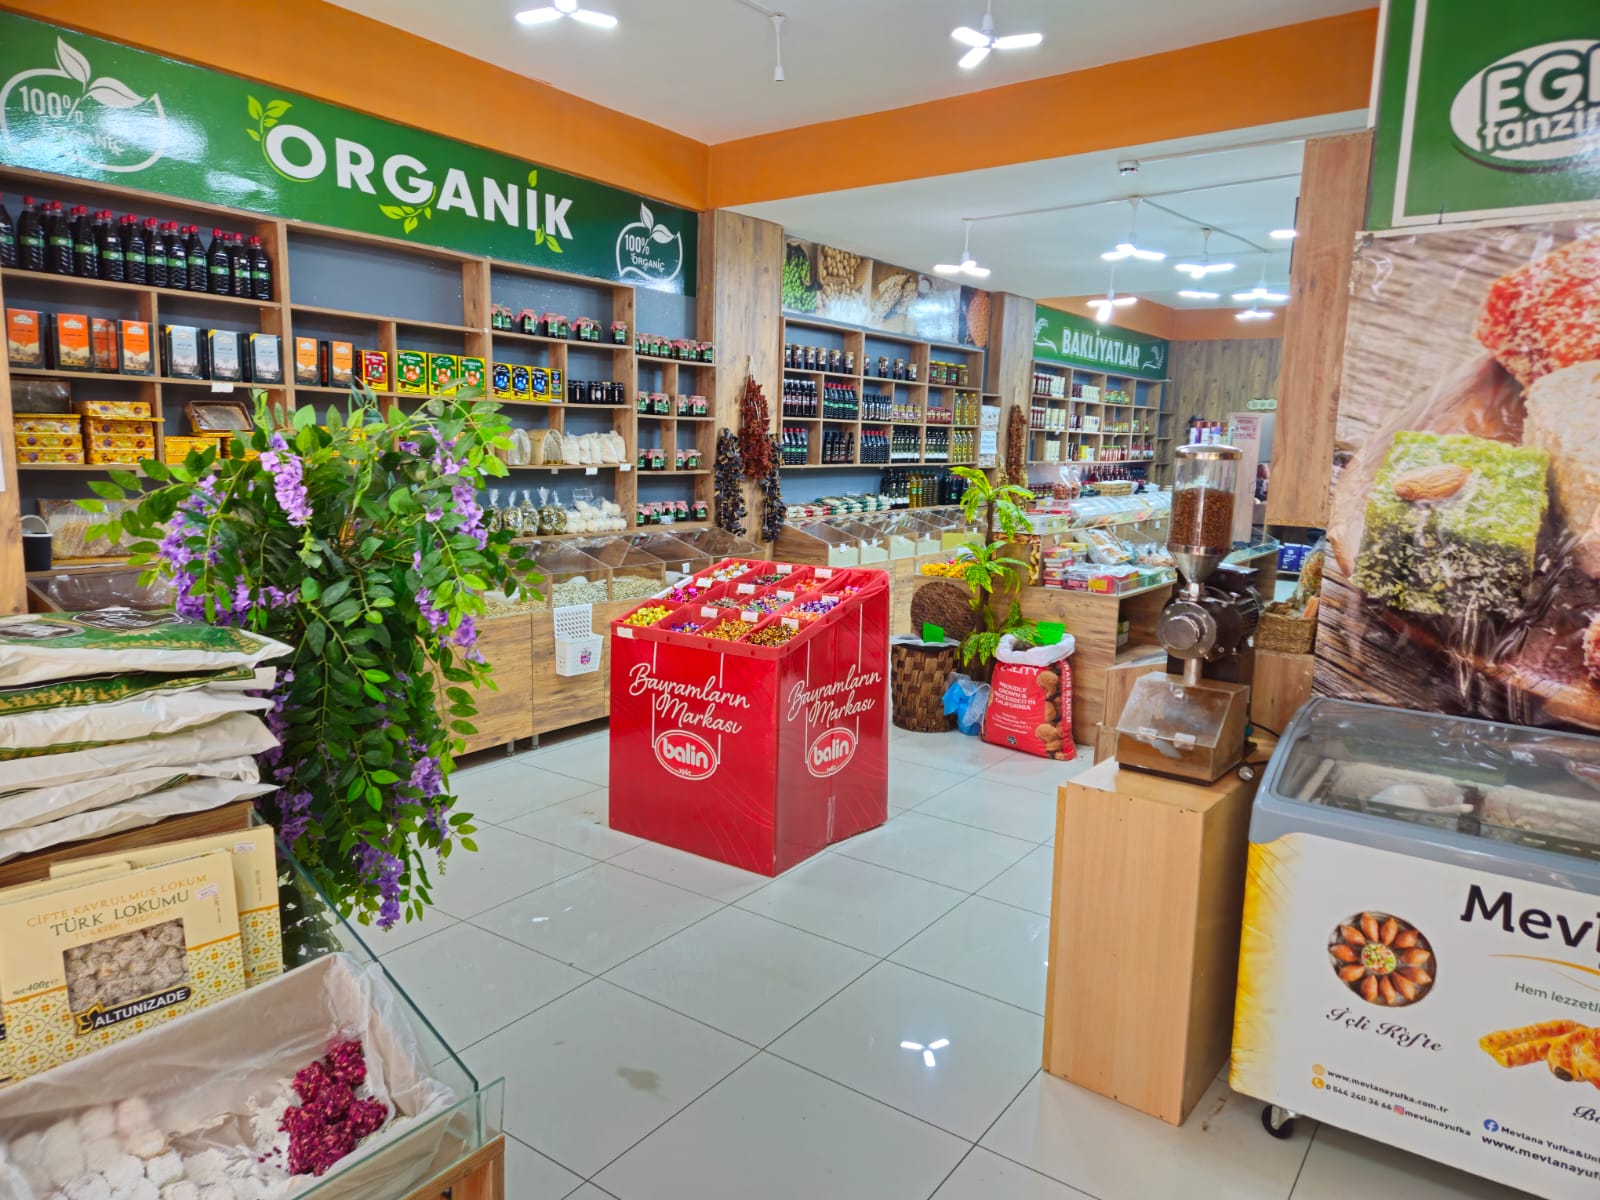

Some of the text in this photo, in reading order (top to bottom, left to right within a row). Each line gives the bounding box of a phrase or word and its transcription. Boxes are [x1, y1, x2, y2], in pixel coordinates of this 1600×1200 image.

[19, 85, 83, 124] 100%
[624, 233, 650, 255] 100%
[662, 737, 709, 769] balin
[813, 738, 849, 766] balin
[50, 911, 103, 937] TÜRK
[114, 890, 190, 921] LOKUMU
[1460, 883, 1600, 954] Mev
[1514, 981, 1600, 1014] Hem lezzetl
[1326, 1069, 1449, 1114] www.mevlanayufka.com.tr
[1404, 1108, 1472, 1137] mevlanayufka
[1501, 1125, 1544, 1146] Mevlana
[1481, 1135, 1600, 1181] www.mevlanayuf
